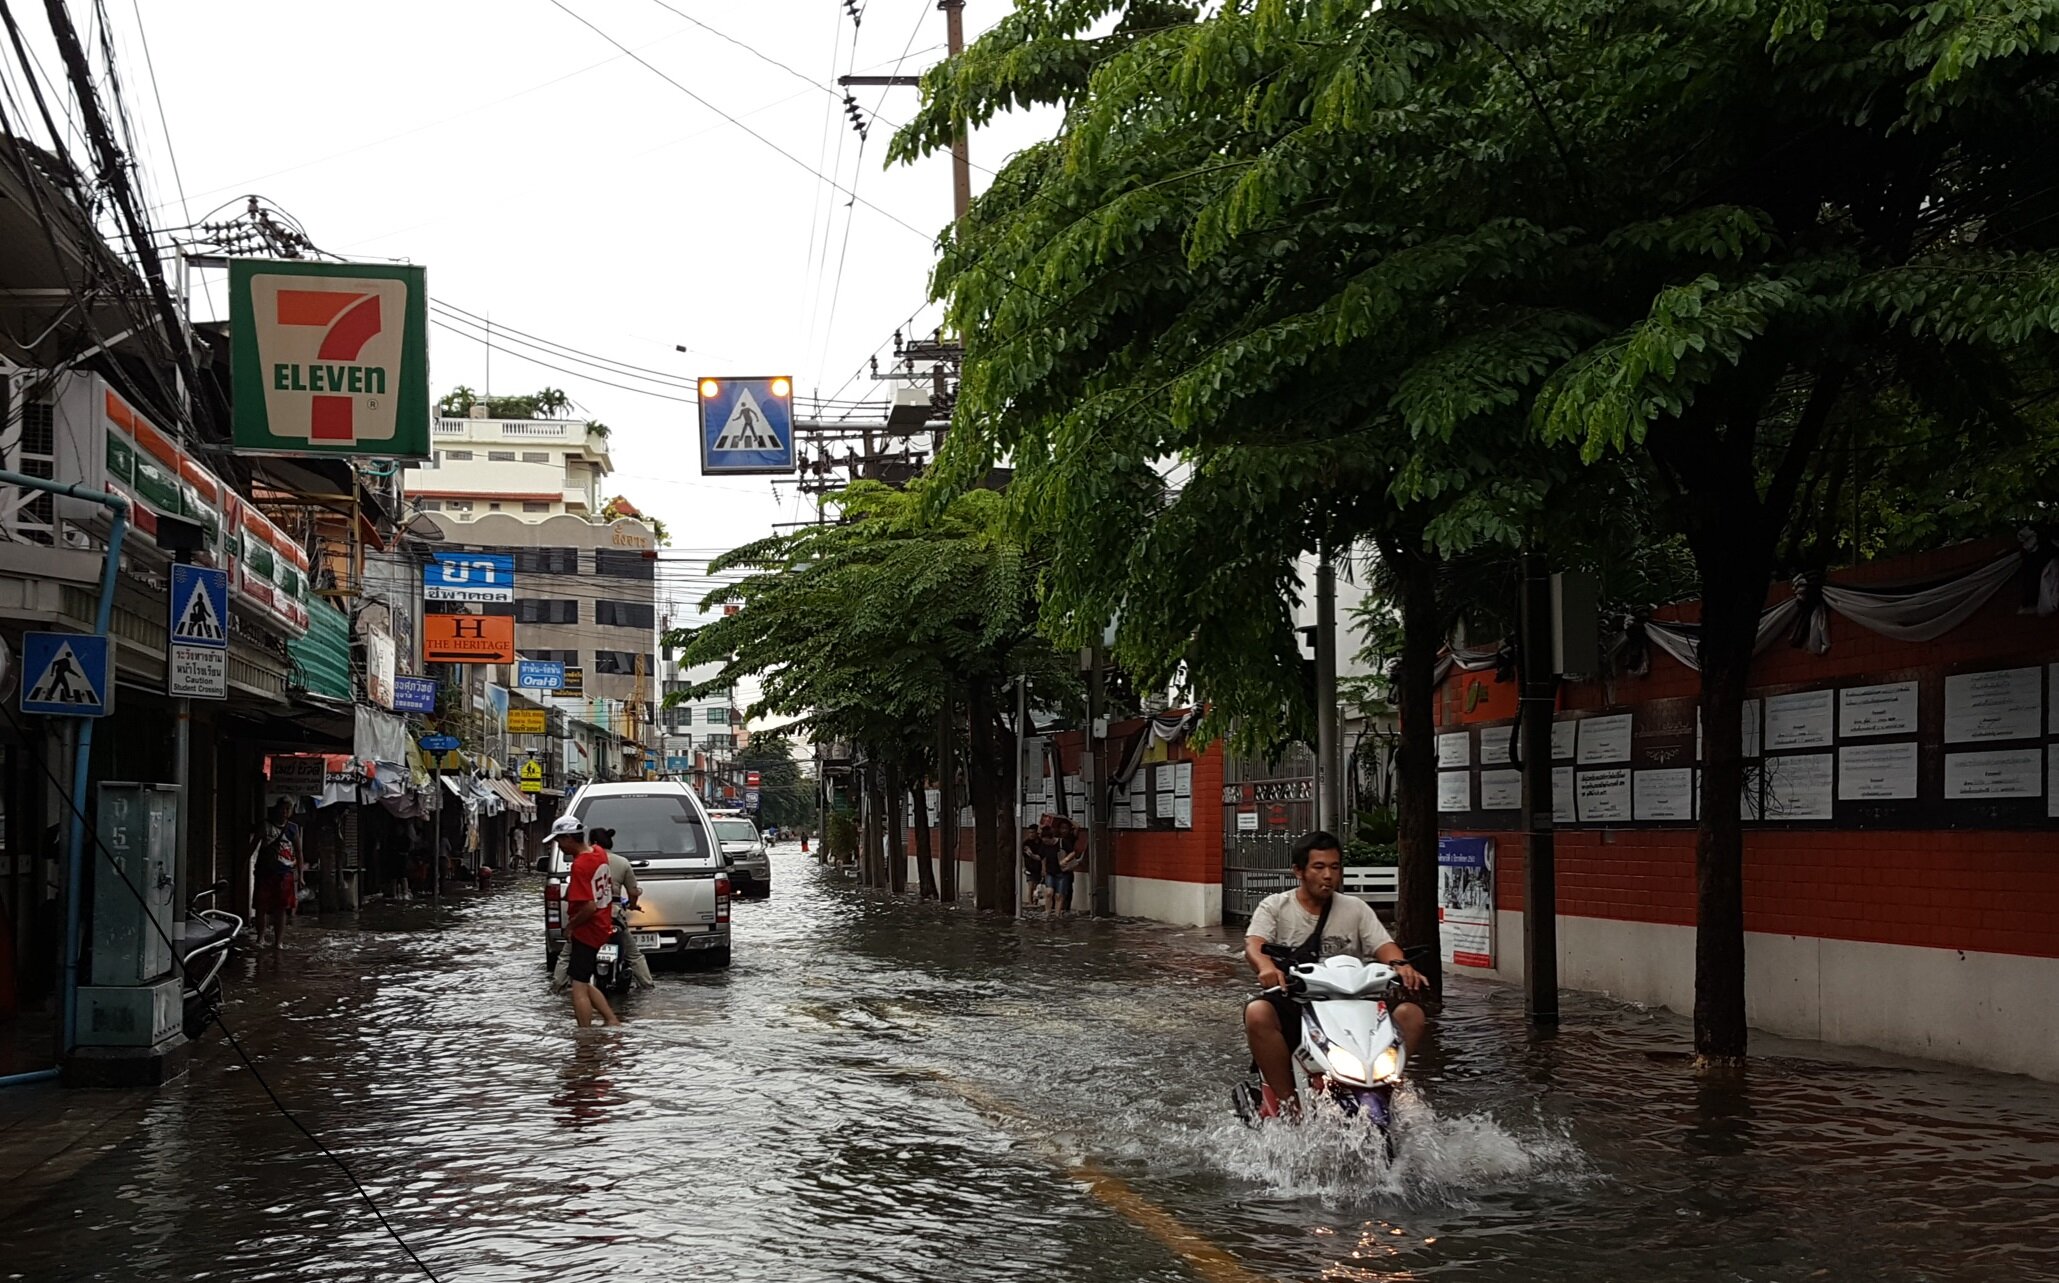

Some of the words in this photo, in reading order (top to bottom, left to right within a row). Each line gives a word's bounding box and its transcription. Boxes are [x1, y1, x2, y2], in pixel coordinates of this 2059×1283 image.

[442, 560, 495, 583] ยา
[451, 618, 487, 638] H
[426, 640, 449, 649] THE
[454, 641, 510, 650] HERITAGE
[185, 676, 214, 685] Caution
[523, 676, 558, 687] Oral-B
[174, 683, 196, 692] Student
[198, 685, 223, 695] Crossing
